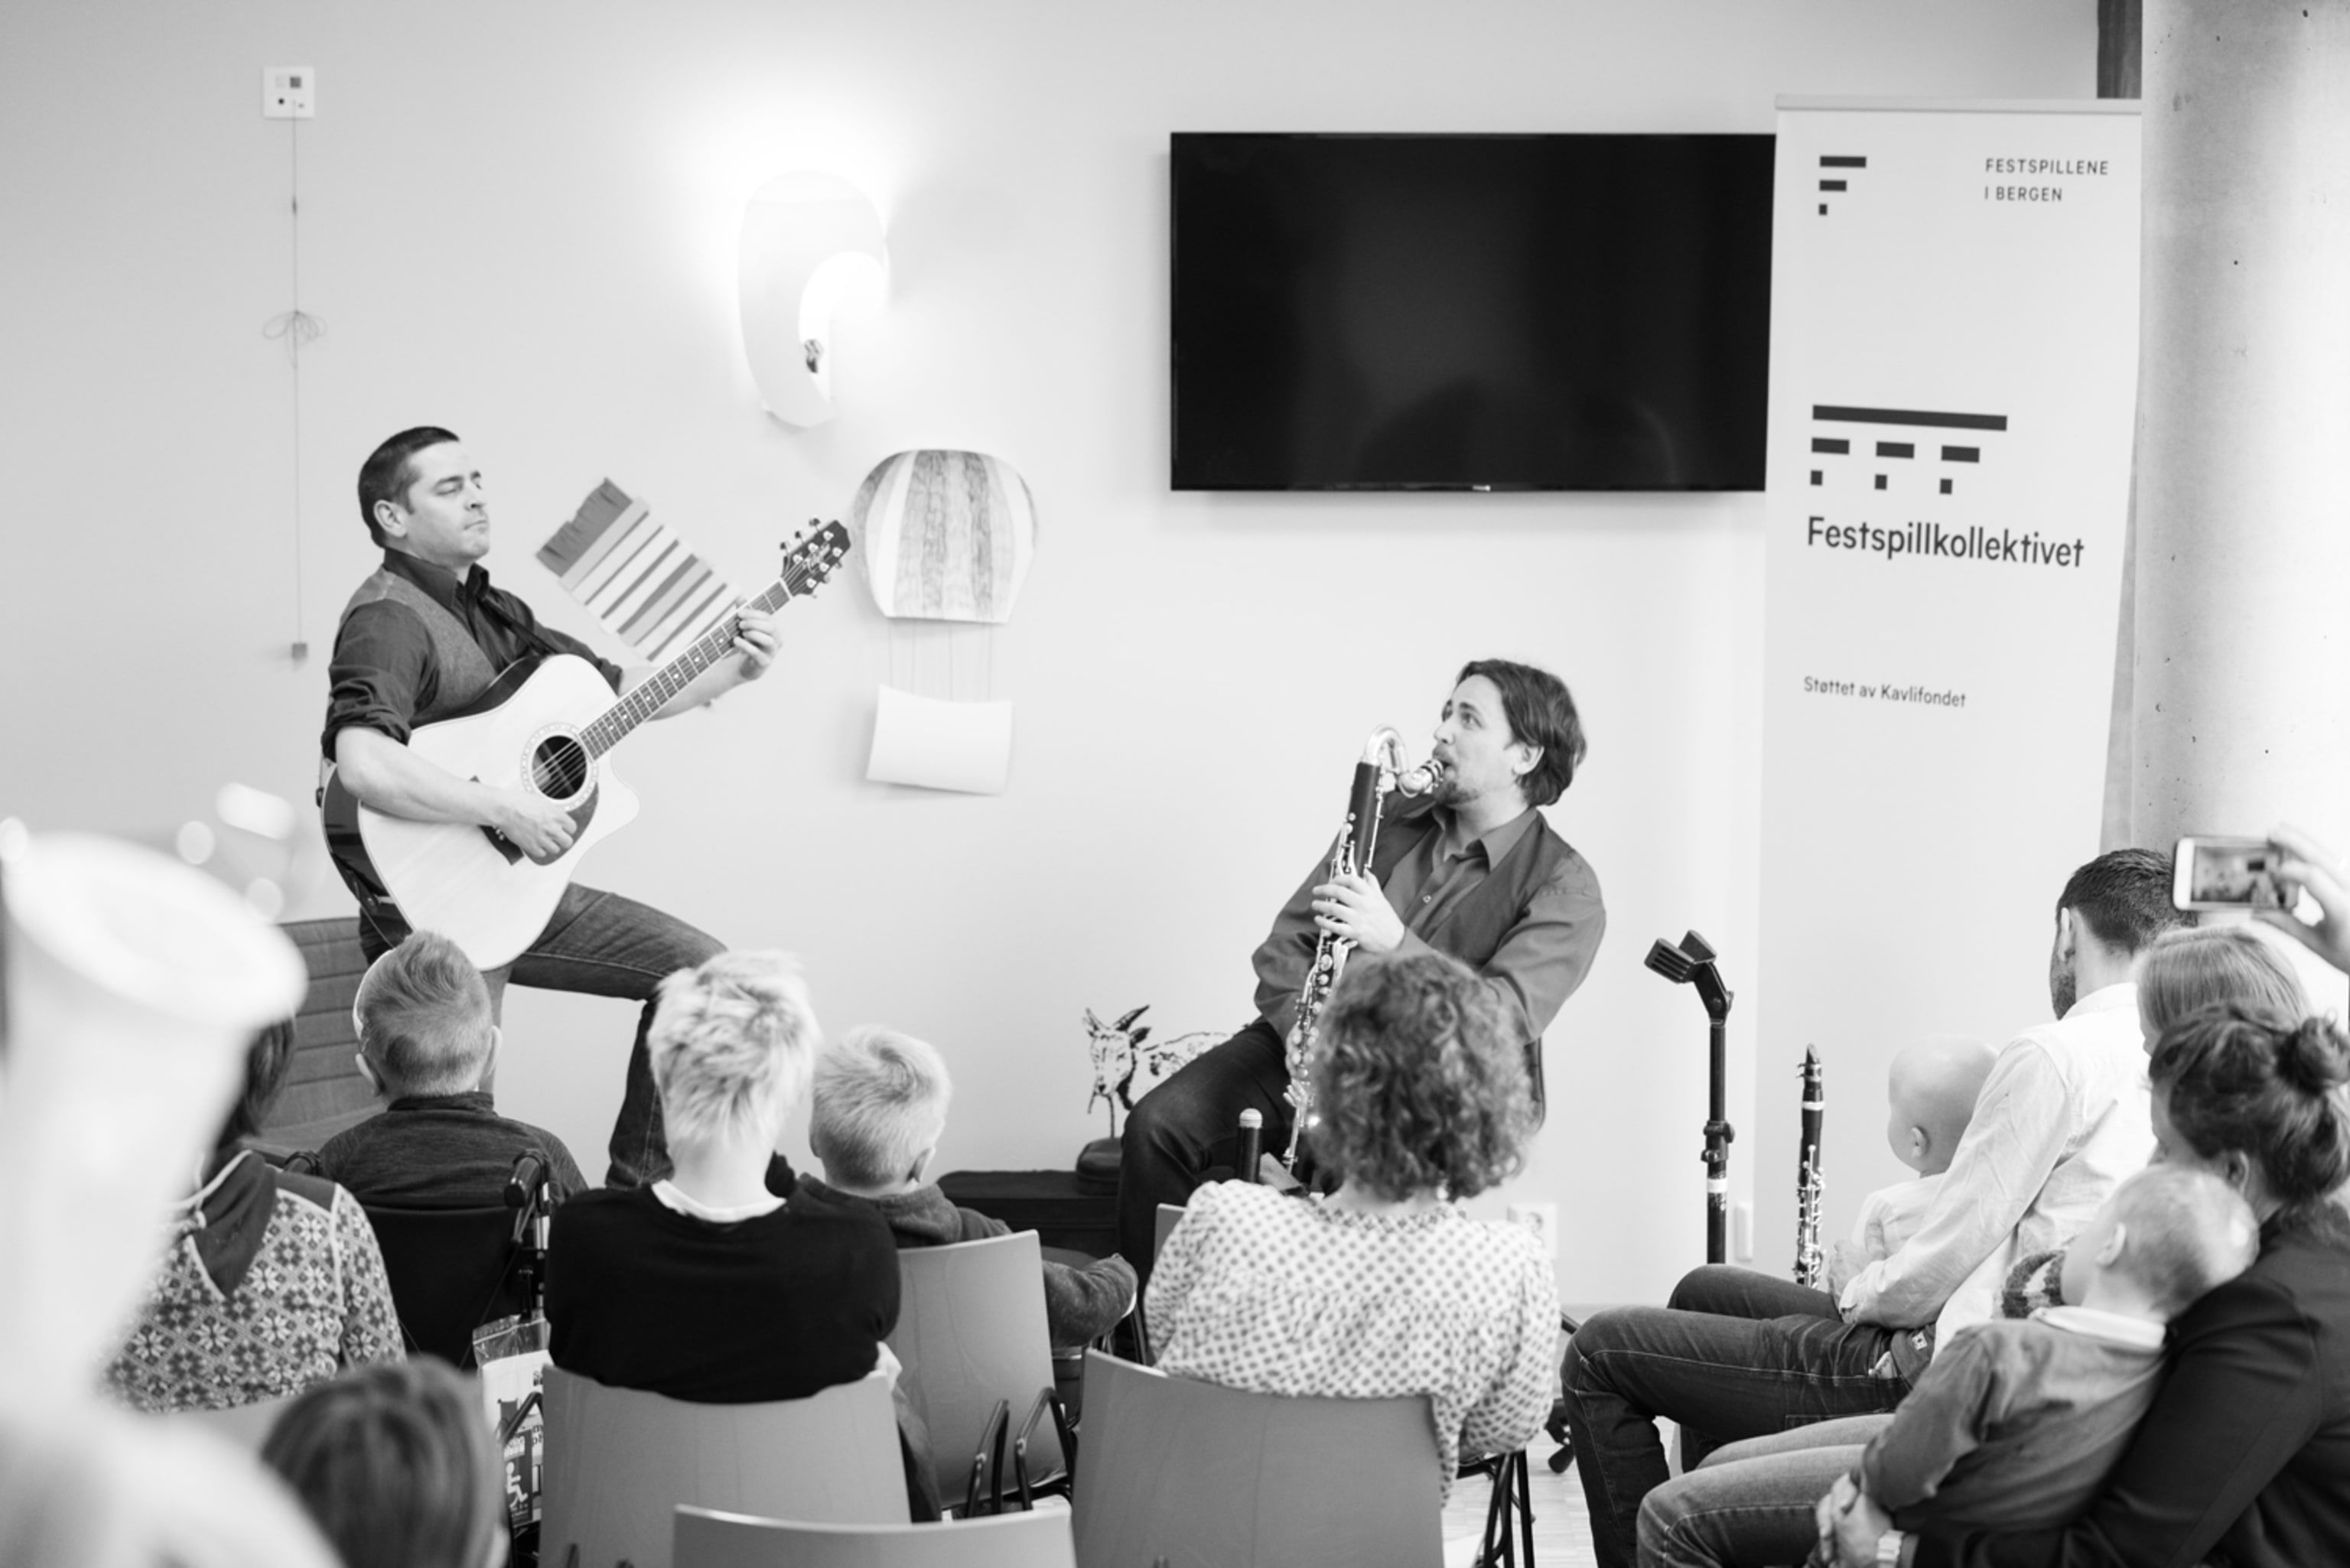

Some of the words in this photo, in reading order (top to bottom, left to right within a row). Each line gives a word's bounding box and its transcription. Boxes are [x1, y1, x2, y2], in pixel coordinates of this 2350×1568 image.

[1985, 158, 2109, 175] FESTSPILLENE
[1984, 186, 1989, 200] I
[1996, 186, 2063, 202] BERGEN
[1808, 515, 2085, 568] Festspillkollektivet
[1804, 676, 1856, 695] Støttet
[1859, 685, 1876, 698] av
[1880, 685, 1966, 707] Kavlifondet
